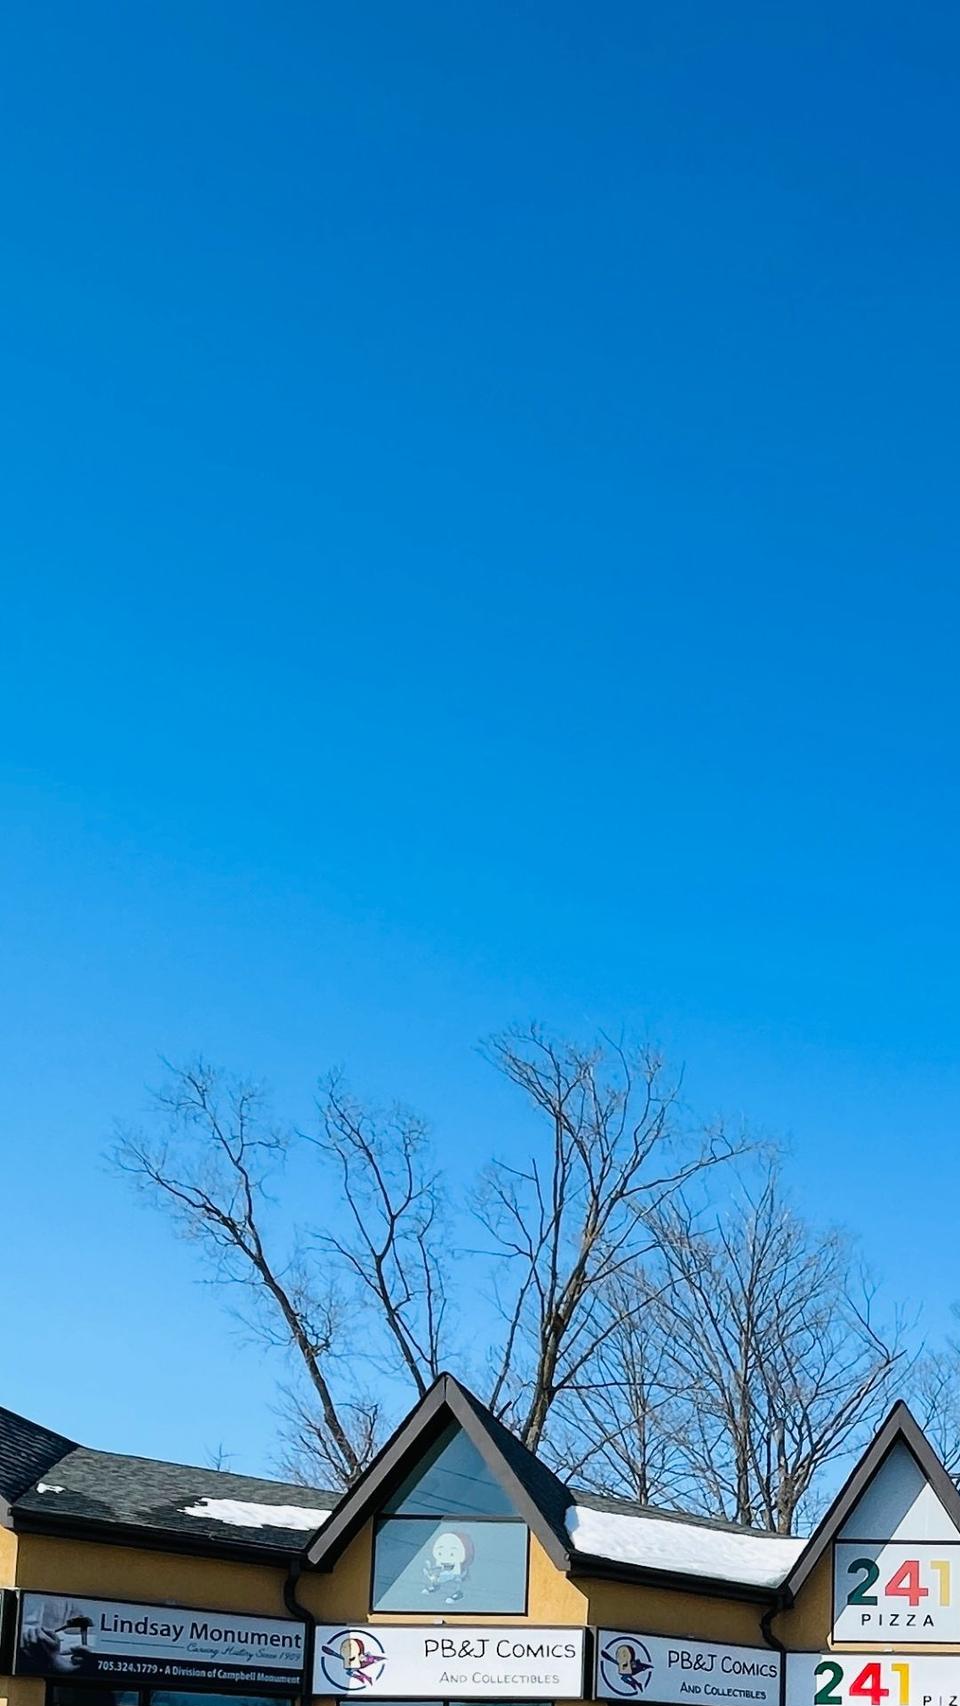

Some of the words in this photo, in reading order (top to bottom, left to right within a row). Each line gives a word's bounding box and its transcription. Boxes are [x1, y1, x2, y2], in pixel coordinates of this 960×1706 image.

[847, 1558, 950, 1606] 241
[100, 1613, 184, 1642] Lindsay
[190, 1622, 302, 1648] Monument
[861, 1614, 934, 1626] PIZZA
[424, 1639, 489, 1658] PB&J
[98, 1660, 158, 1673] 705.324.1779
[164, 1665, 171, 1675] A
[172, 1666, 206, 1678] Division
[207, 1668, 217, 1678] of
[217, 1668, 256, 1682] Campbell
[257, 1672, 301, 1684] Monument
[668, 1650, 717, 1672] PB&J
[814, 1661, 909, 1706] 241
